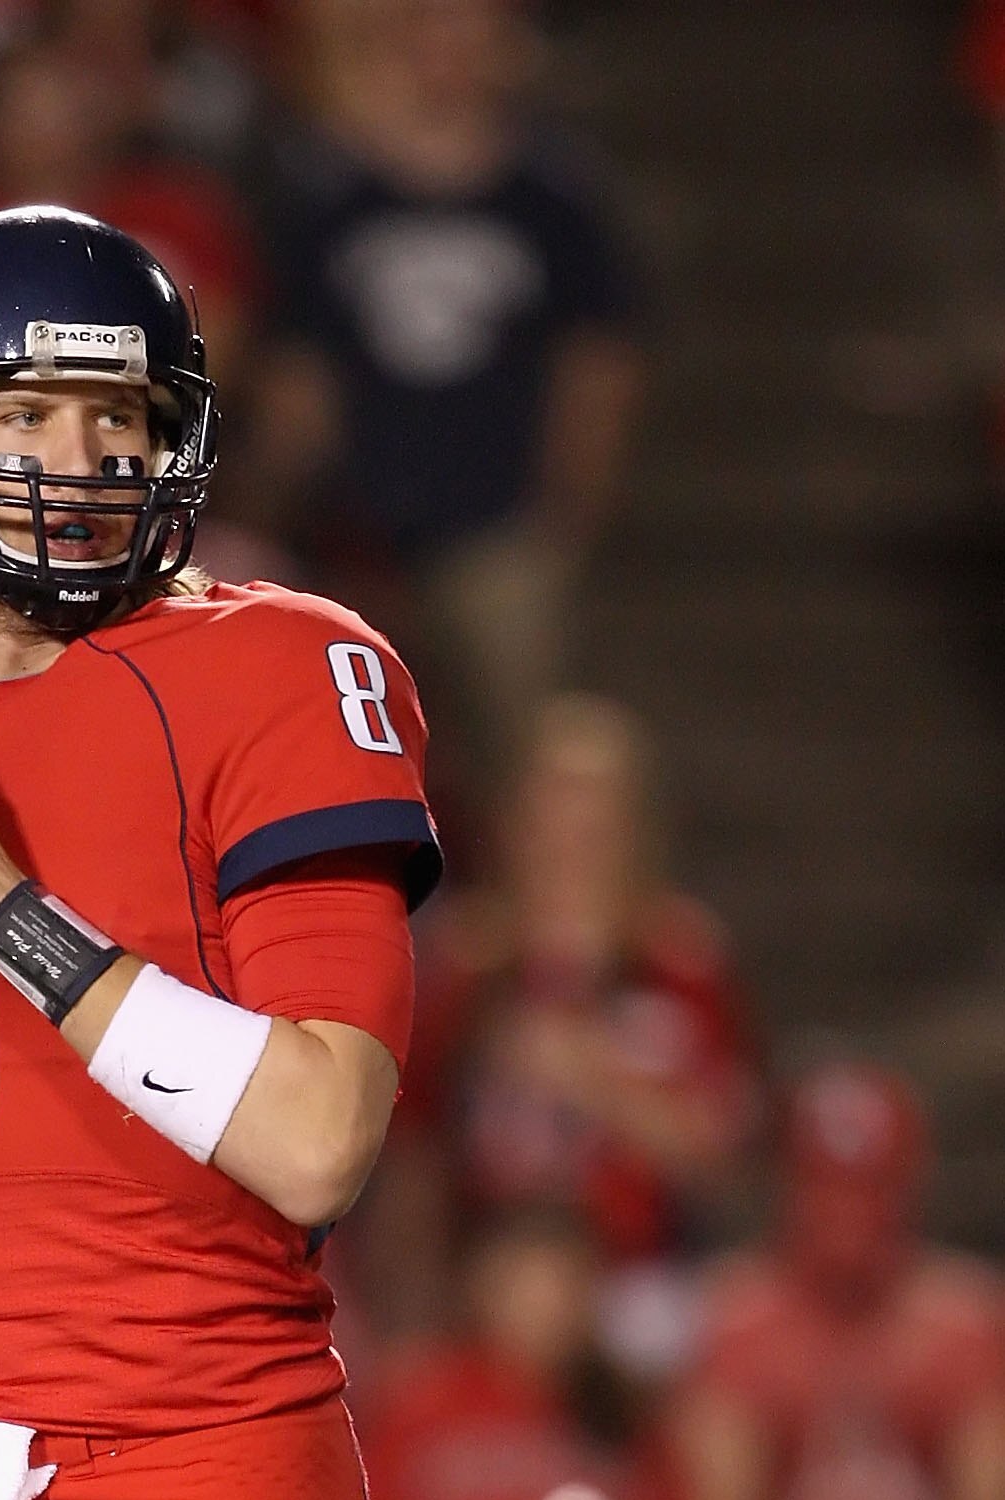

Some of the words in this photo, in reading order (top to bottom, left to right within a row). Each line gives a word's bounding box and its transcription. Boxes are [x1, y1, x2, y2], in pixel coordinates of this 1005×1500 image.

[55, 331, 116, 344] PAC-10
[116, 456, 133, 476] A
[58, 590, 100, 602] Riddell
[325, 641, 404, 755] 8
